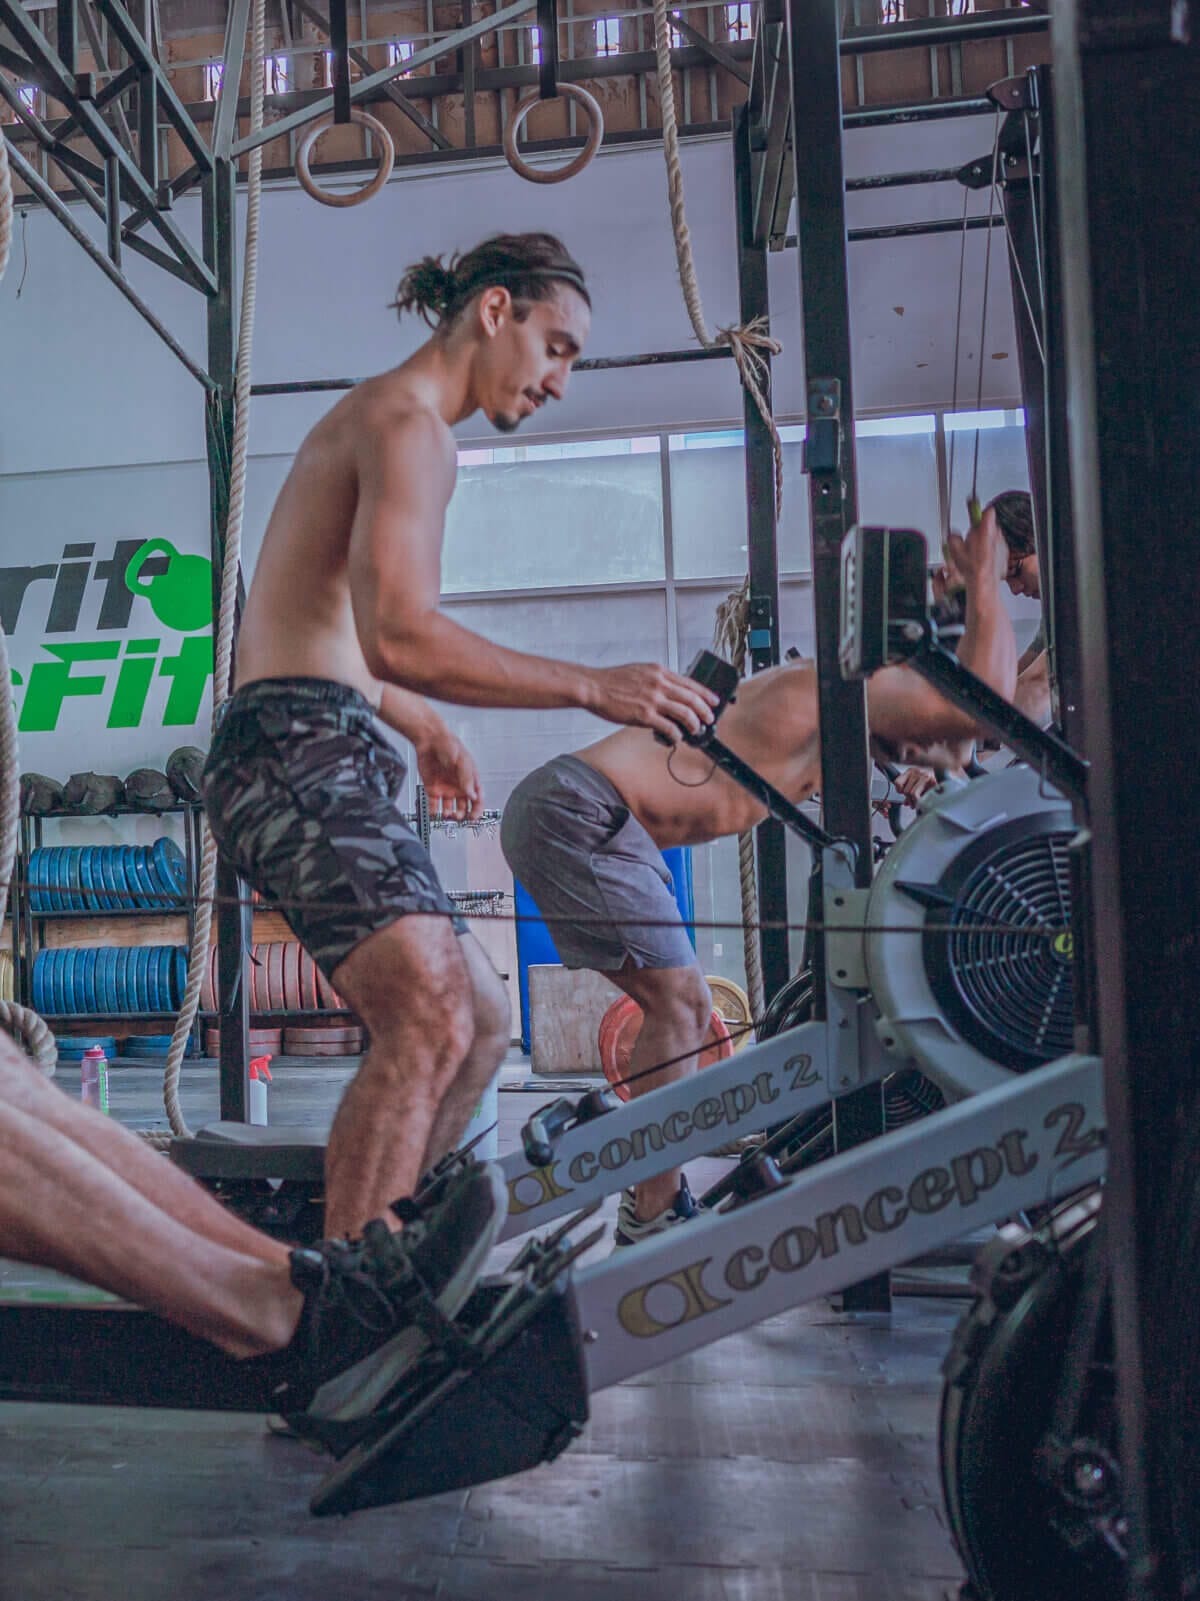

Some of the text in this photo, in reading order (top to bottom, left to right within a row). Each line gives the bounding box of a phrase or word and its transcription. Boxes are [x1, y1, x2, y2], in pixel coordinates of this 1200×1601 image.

[568, 1053, 823, 1183] concept 2
[723, 1102, 1104, 1292] concept 2
